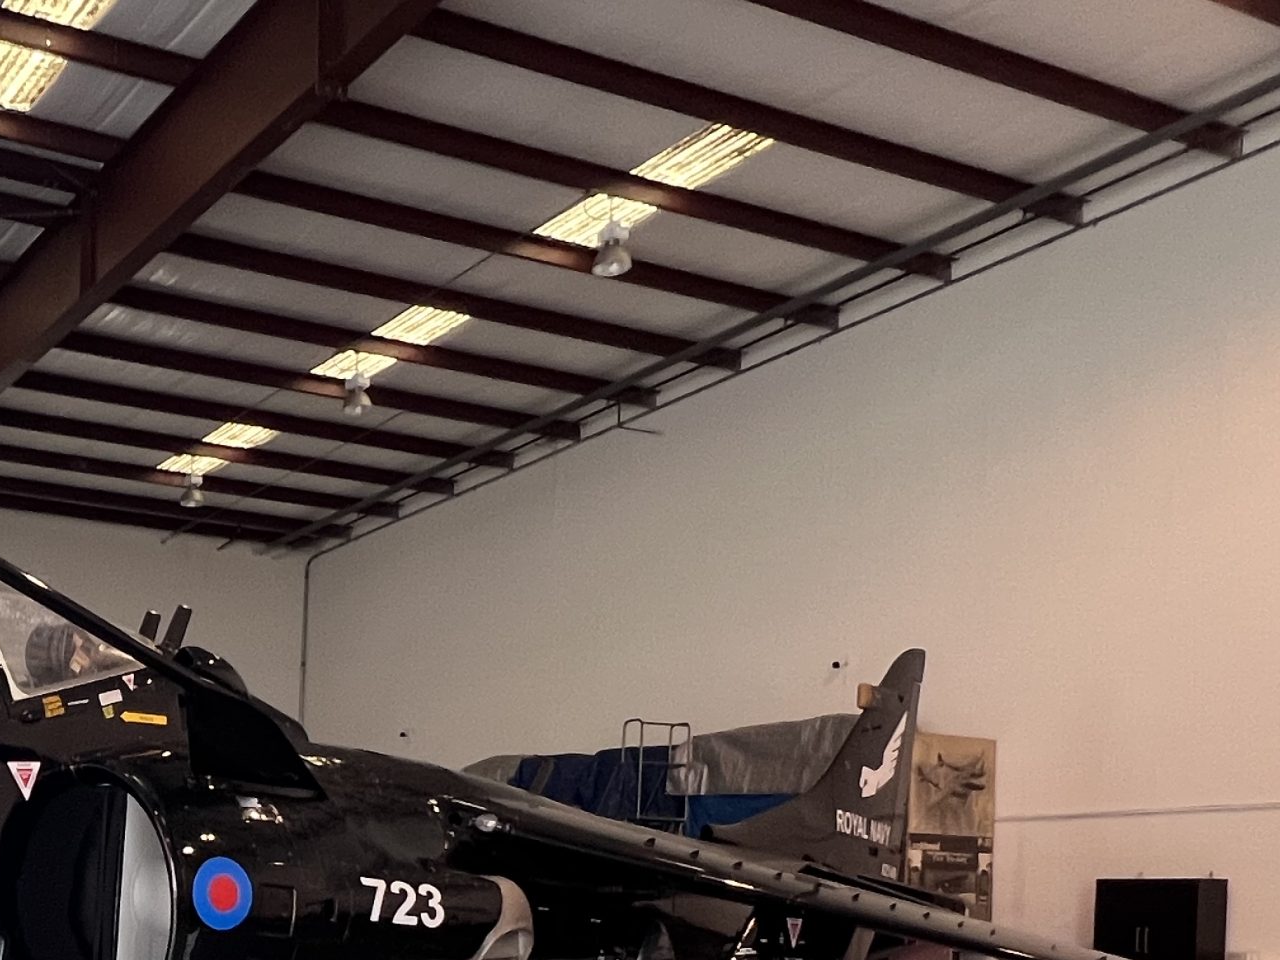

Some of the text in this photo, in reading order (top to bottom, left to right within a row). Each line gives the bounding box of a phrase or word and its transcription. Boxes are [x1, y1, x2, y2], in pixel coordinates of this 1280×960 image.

[836, 809, 891, 846] ROYAL NAVY
[360, 876, 445, 928] 723
